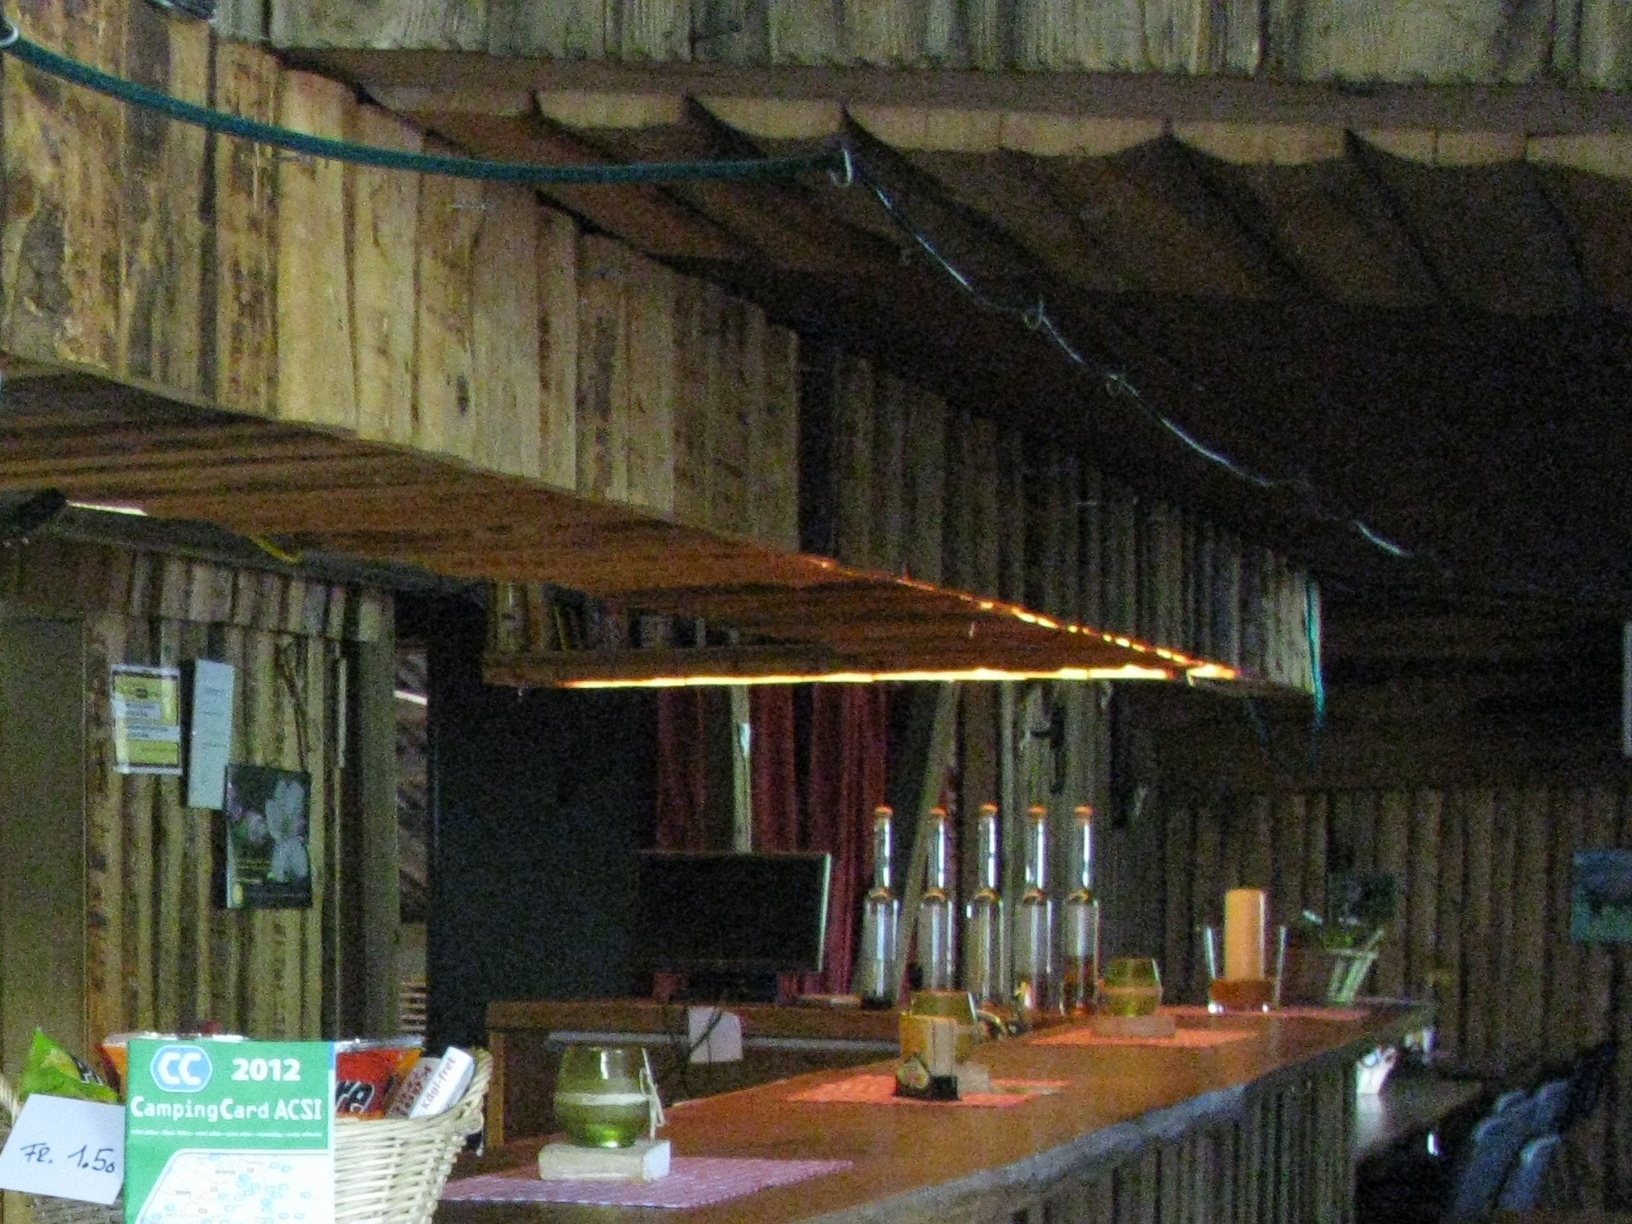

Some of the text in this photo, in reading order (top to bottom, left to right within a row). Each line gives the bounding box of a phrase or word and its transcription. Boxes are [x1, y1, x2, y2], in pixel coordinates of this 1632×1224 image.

[157, 1052, 302, 1086] CC 2012
[130, 1095, 323, 1123] CampingCard ACSI
